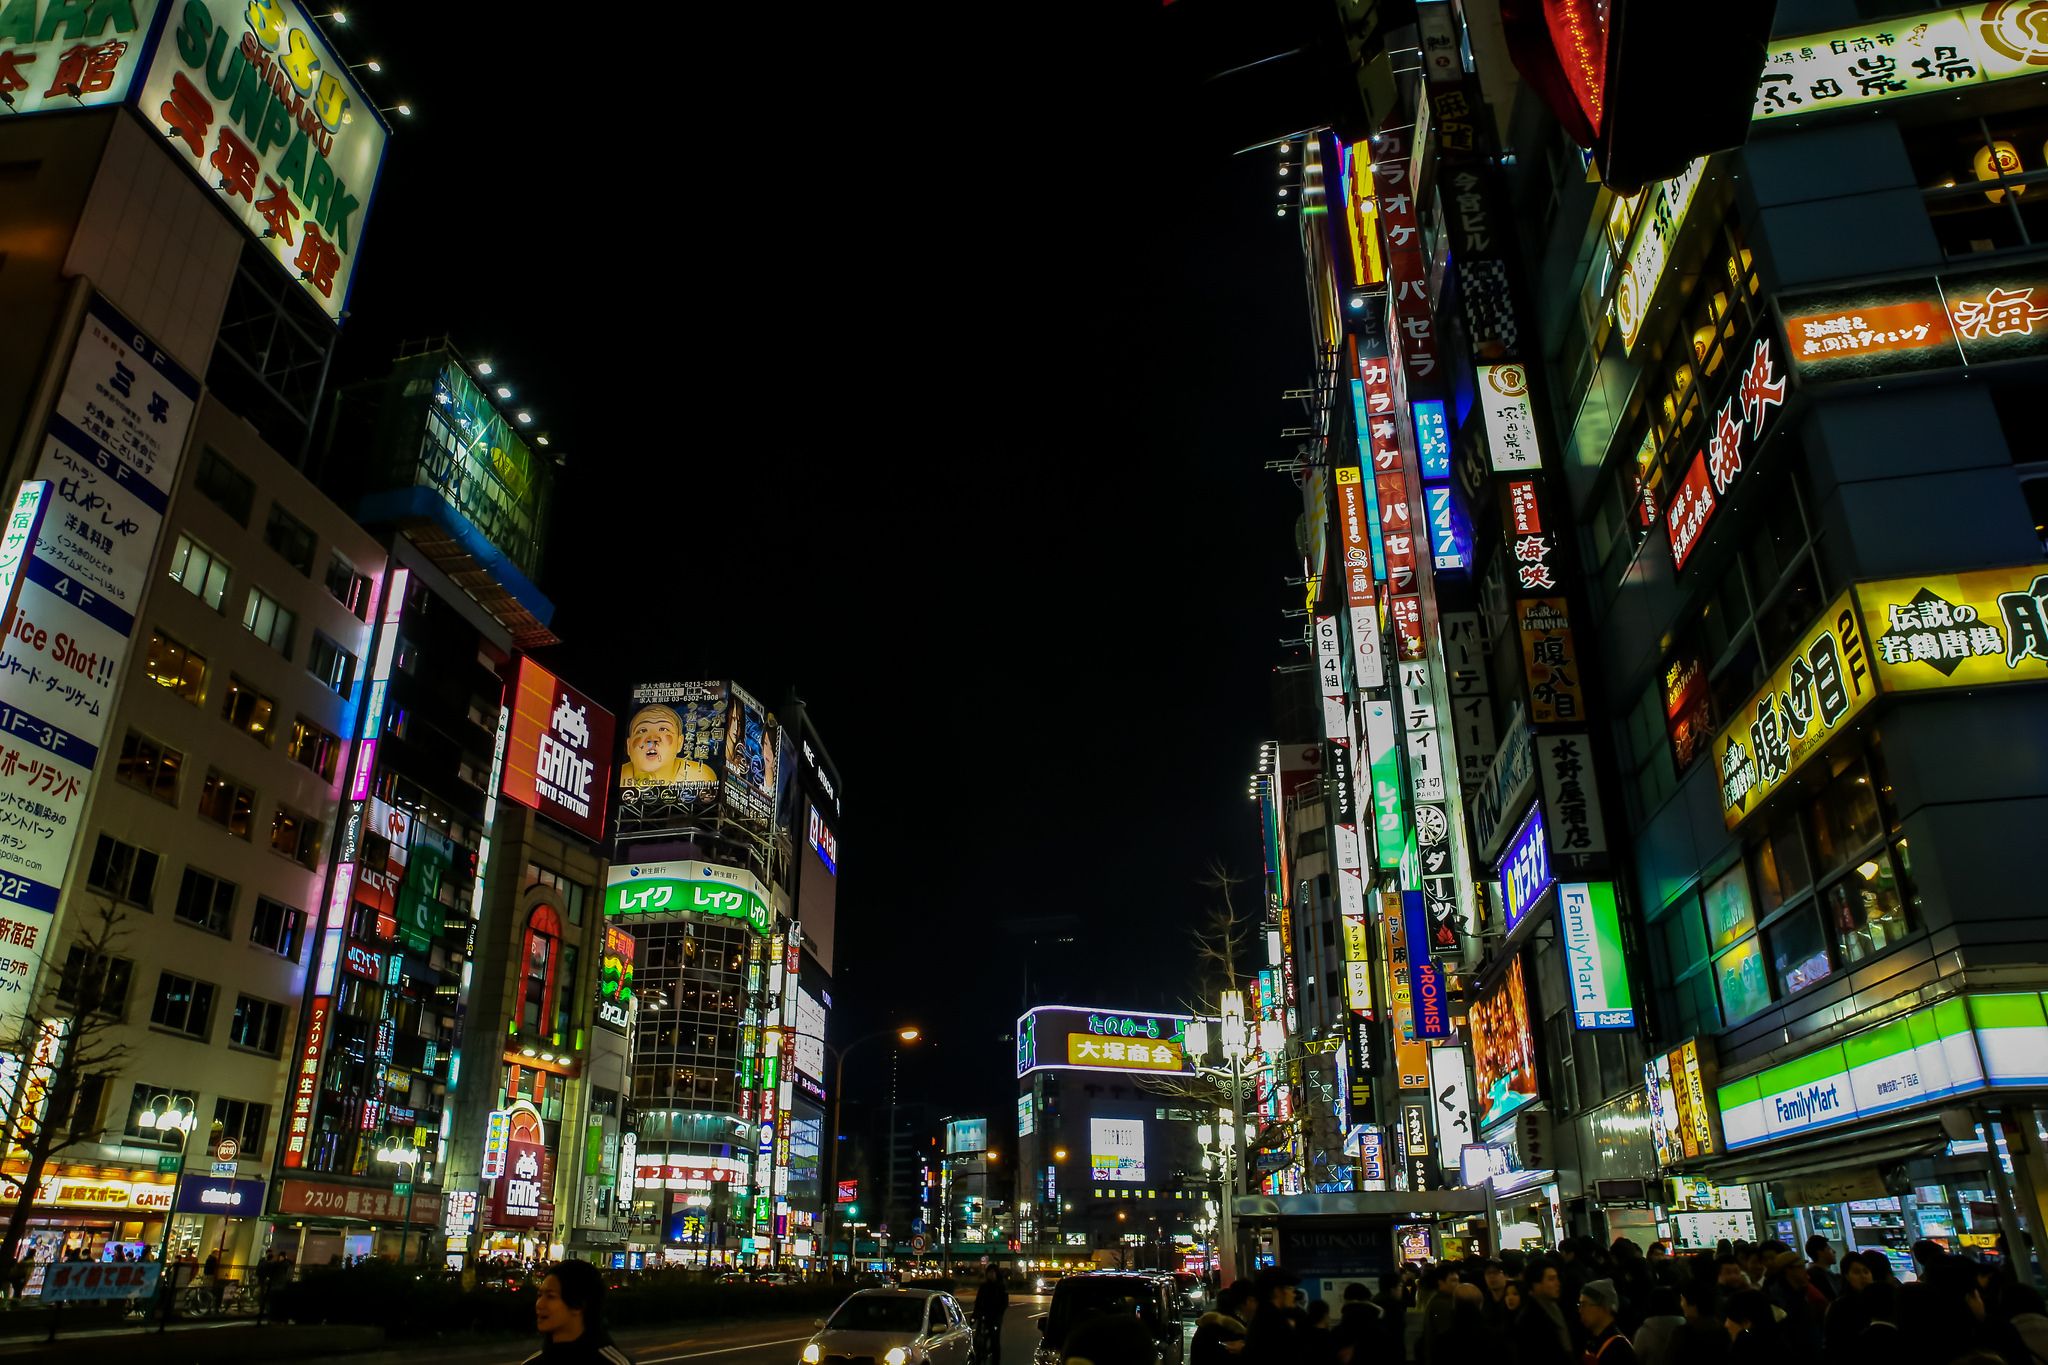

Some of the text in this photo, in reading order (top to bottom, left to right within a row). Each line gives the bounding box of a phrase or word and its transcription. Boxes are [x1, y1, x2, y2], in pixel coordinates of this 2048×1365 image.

[241, 31, 334, 158] SHINJUKU
[176, 0, 361, 255] SUNPARK
[1377, 135, 1437, 378] カラオケ パセラ
[53, 447, 98, 484] レストラン
[96, 450, 131, 480] 5F
[1338, 469, 1358, 483] 8F
[1365, 365, 1415, 588] カラオケ パセラ
[58, 477, 140, 537] はやしや
[1432, 488, 1455, 553] 747
[65, 513, 114, 555] 洋風料理
[54, 577, 95, 607] 4F
[1407, 600, 1419, 622] 名物
[8, 609, 47, 651] ice
[1889, 600, 1977, 633] 伝説の
[1319, 623, 1341, 688] 6年4組
[1878, 626, 2003, 664] 若鶏唐揚
[1405, 669, 1435, 771] パーティー
[0, 745, 81, 803] ポーツランド
[536, 733, 594, 803] GAME
[1414, 777, 1441, 791] 貸切
[535, 777, 589, 819] TAITO STATION
[1376, 780, 1400, 831] レイク
[1551, 738, 1592, 850] 水野屋酒店
[641, 866, 667, 875] 新生銀行
[713, 871, 739, 880] 新生銀行
[1421, 849, 1451, 922] ダーツ
[619, 886, 673, 910] レイク
[694, 886, 743, 911] レイク
[749, 897, 766, 928] レイク
[1388, 915, 1400, 944] セット
[1566, 892, 1598, 1002] FamilyMart
[0, 959, 29, 977] 日夕市
[1350, 925, 1363, 998] アラビアンロック
[1419, 964, 1441, 1034] PROMISE
[1088, 1014, 1160, 1039] たのめーる
[1076, 1040, 1175, 1064] 大塚商会
[1402, 1075, 1426, 1086] 3F
[1774, 1082, 1841, 1124] FamilyMart
[136, 1193, 170, 1207] GAME
[305, 1189, 408, 1217] クスリの龍生堂薬
